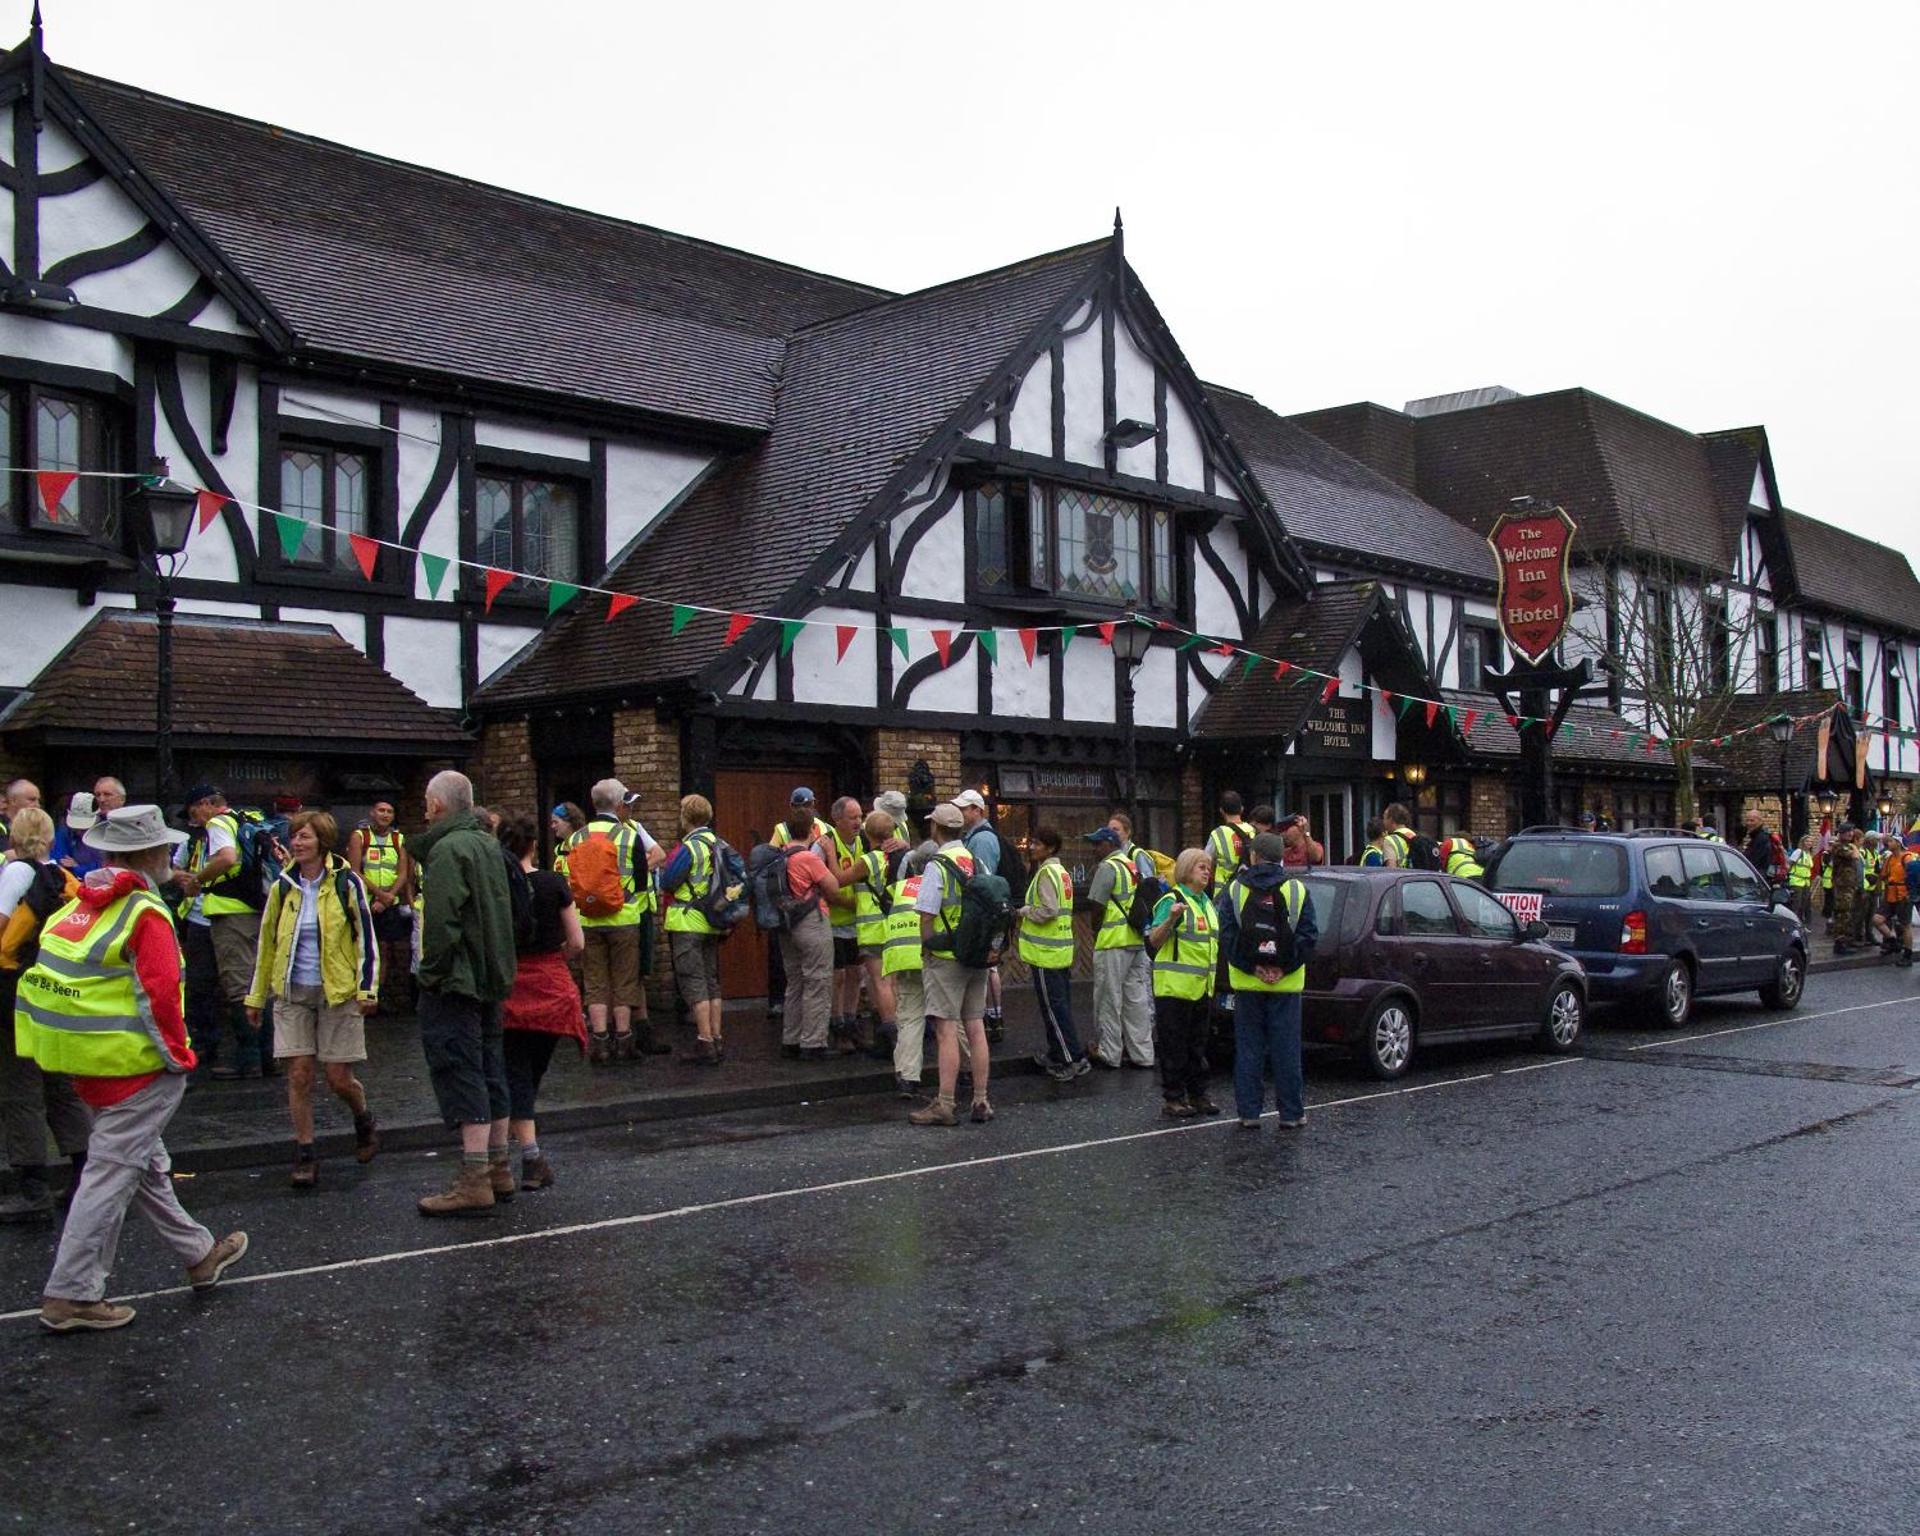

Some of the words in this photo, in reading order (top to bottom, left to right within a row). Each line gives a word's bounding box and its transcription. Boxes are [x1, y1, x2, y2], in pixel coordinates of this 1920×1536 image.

[1518, 529, 1543, 540] The
[1504, 546, 1558, 563] Welcome
[1518, 569, 1547, 583] Inn
[1508, 604, 1560, 624] Hotel
[1328, 707, 1346, 719] THE
[1307, 720, 1347, 733] WELCOME
[1350, 723, 1366, 735] INN
[1323, 736, 1350, 748] HOTEL
[40, 977, 52, 991] Be
[53, 981, 80, 998] Seen
